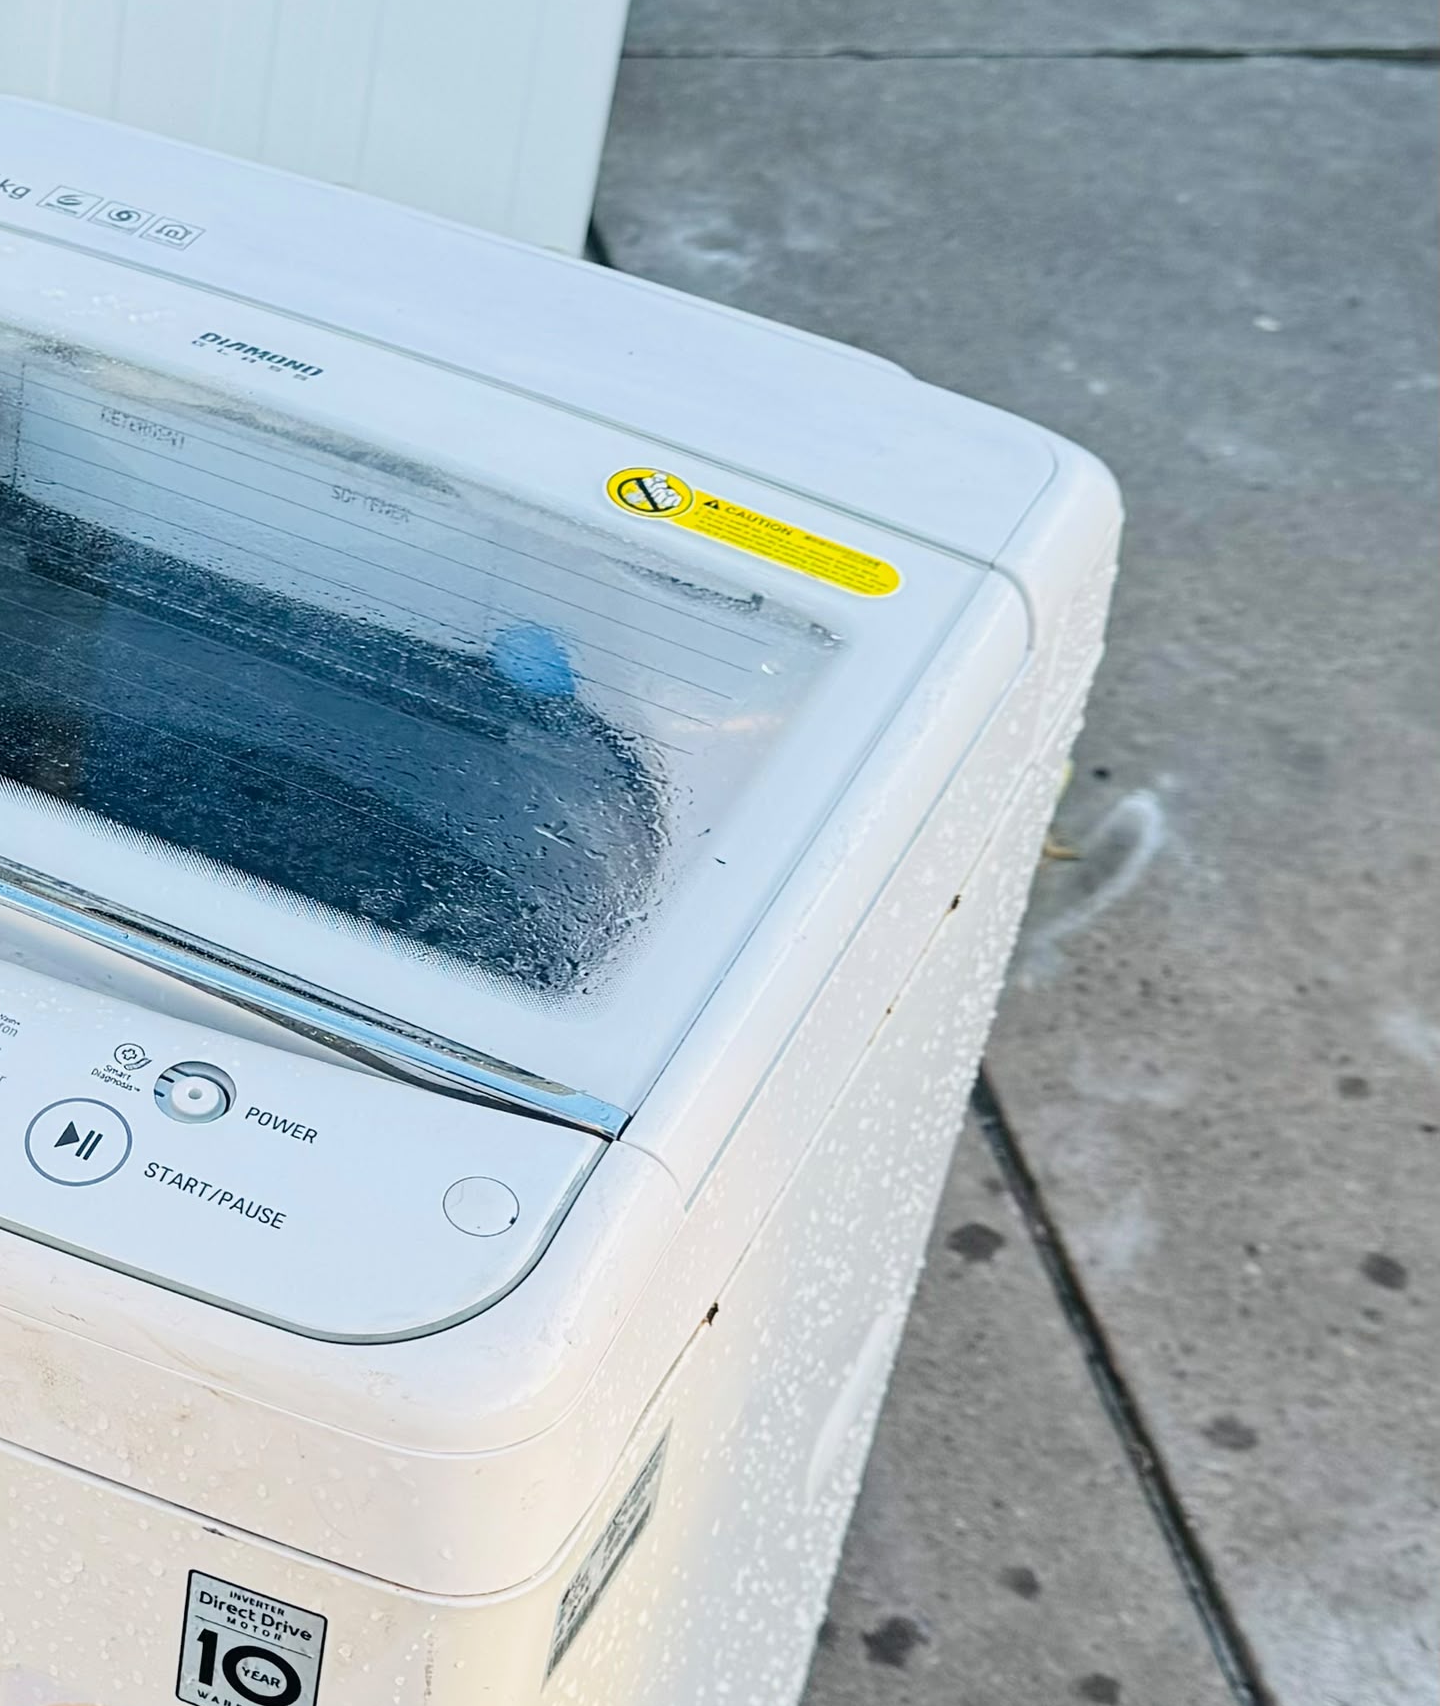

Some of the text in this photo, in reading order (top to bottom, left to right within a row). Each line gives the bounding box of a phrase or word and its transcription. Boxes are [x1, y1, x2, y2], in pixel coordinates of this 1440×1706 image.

[199, 332, 324, 376] DIAMOND
[724, 506, 793, 537] CAUTION
[103, 1064, 132, 1081] Smart
[245, 1106, 319, 1144] POWER
[144, 1162, 287, 1230] START/PAUSE
[198, 1590, 313, 1642] Direct Drive
[229, 1590, 286, 1617] INVERTER
[226, 1616, 282, 1642] MOTOR
[240, 1666, 281, 1689] YEAR
